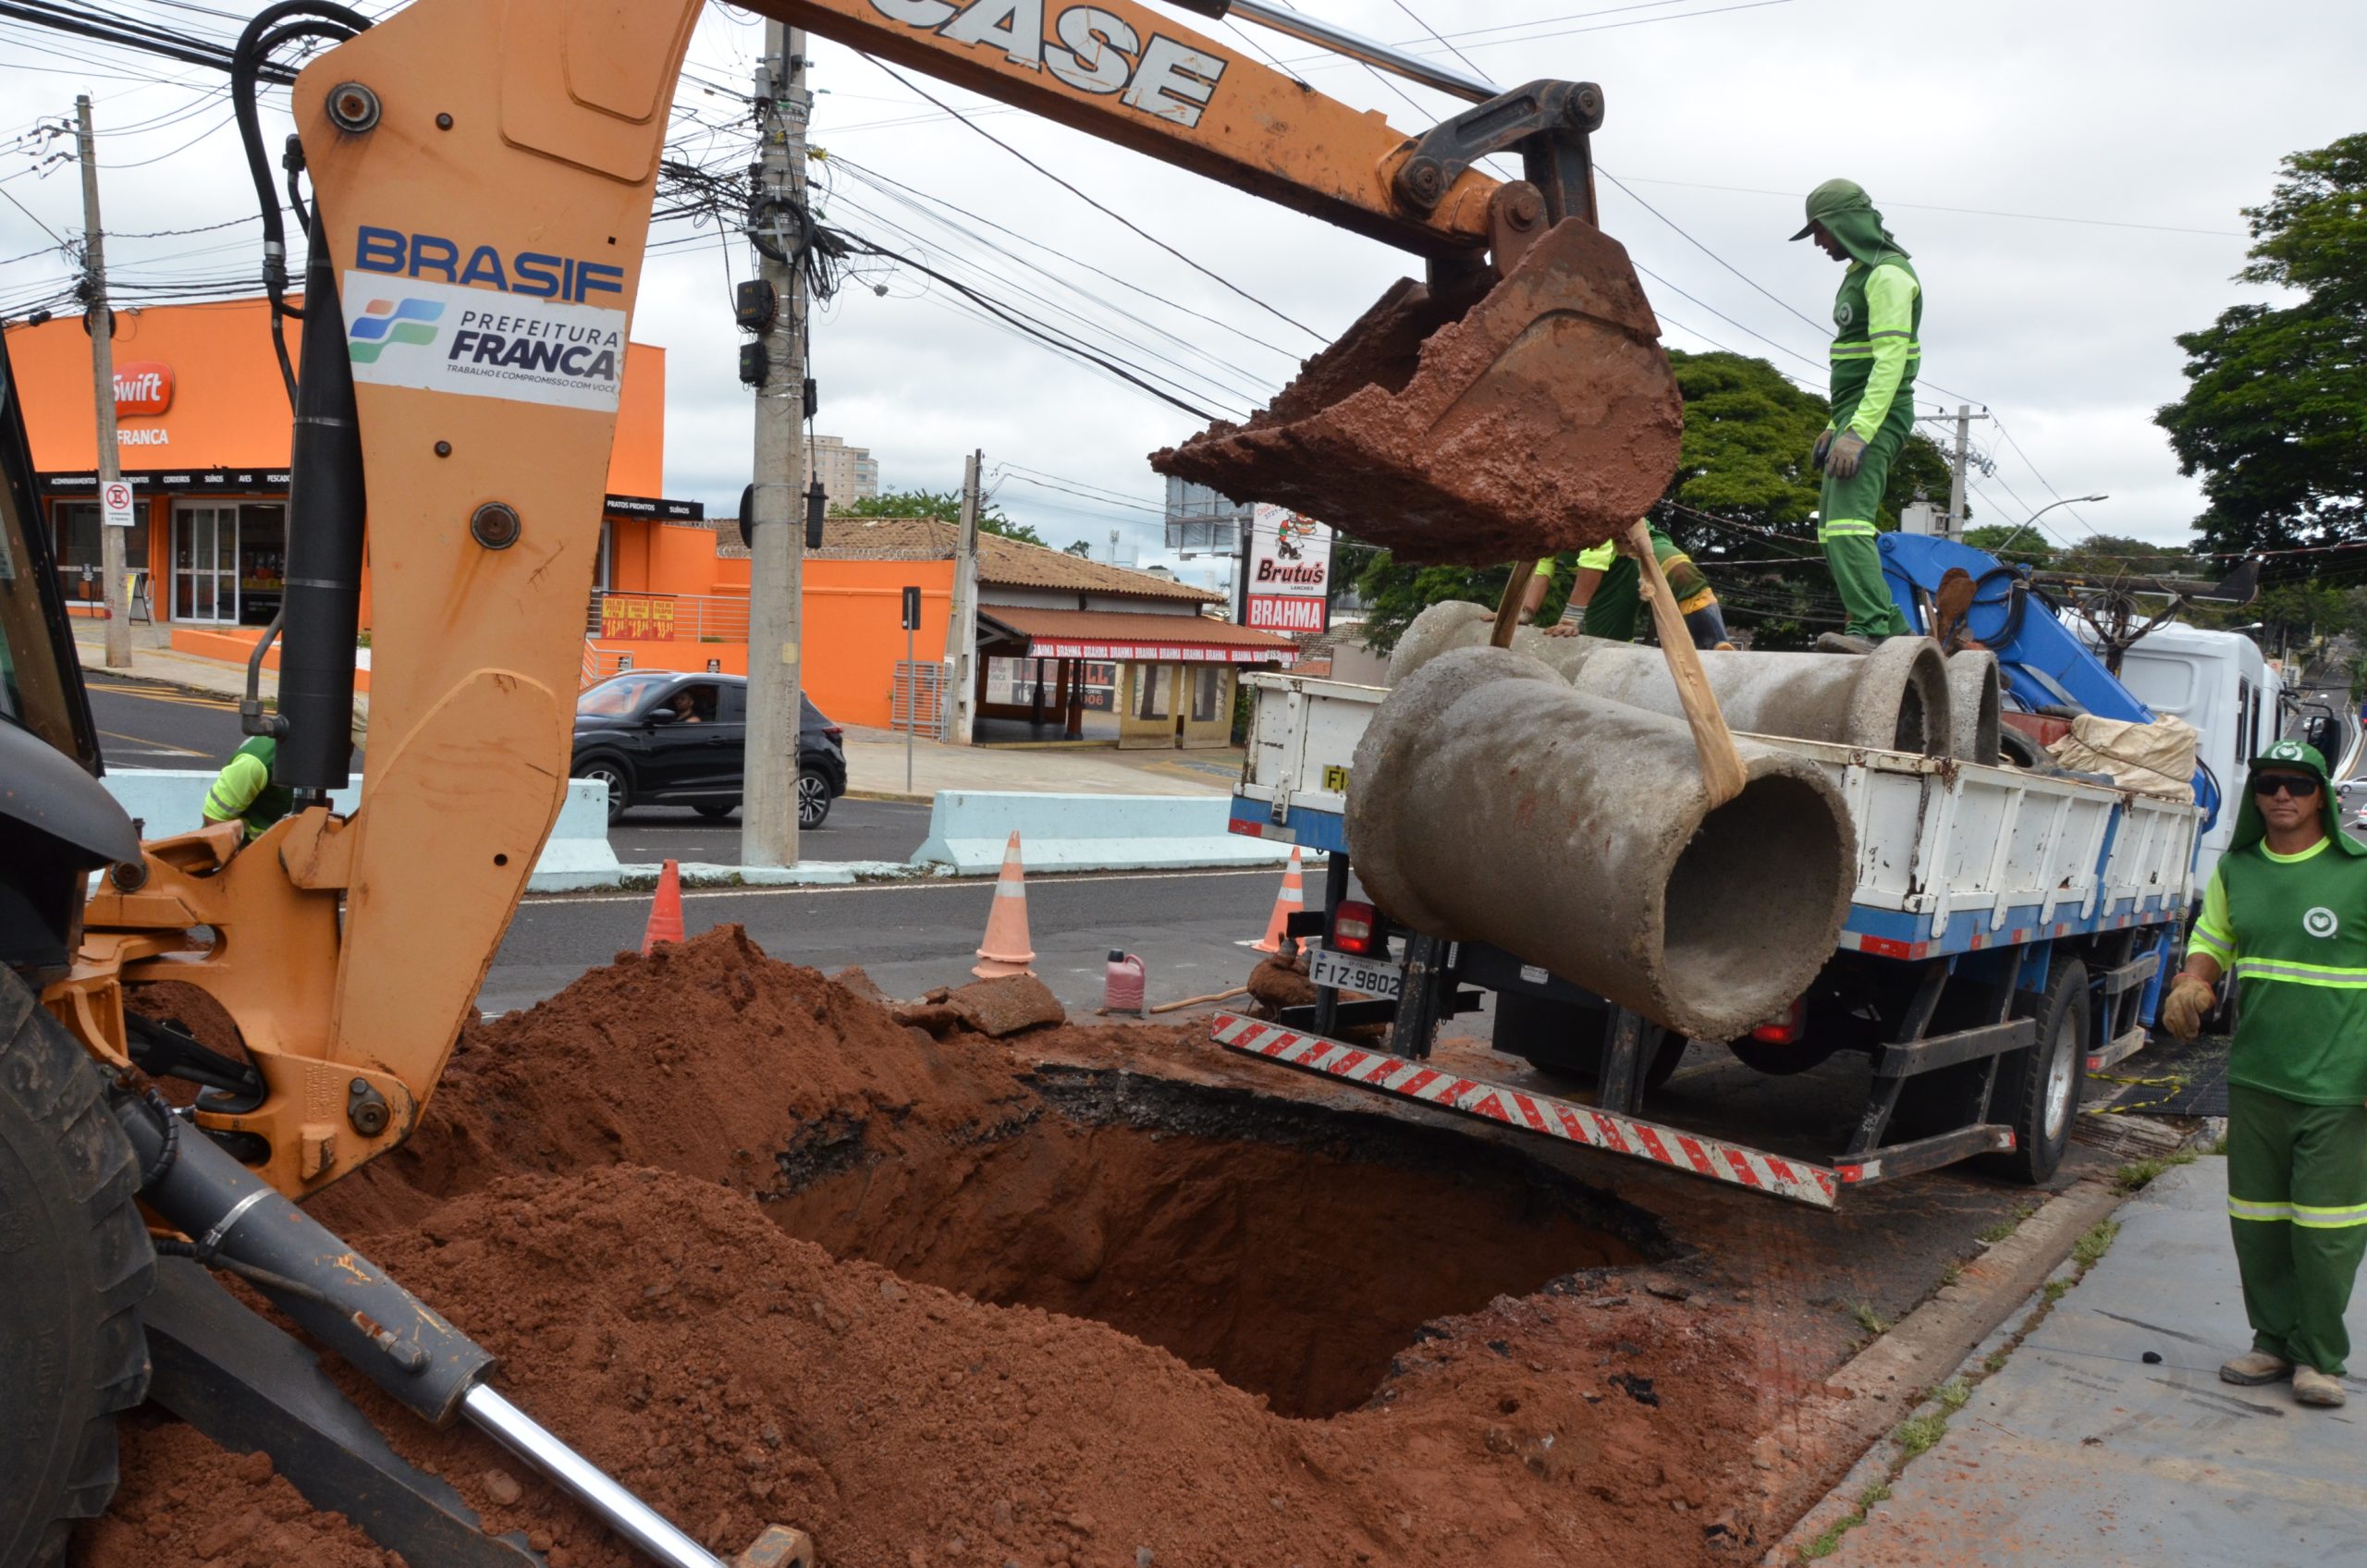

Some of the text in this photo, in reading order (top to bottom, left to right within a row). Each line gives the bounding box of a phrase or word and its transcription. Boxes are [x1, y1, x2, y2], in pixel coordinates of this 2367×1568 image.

[355, 225, 624, 302] BRASIF
[460, 311, 619, 348] PREFEITURA
[448, 330, 615, 381] FRANCA
[113, 373, 162, 401] Swift
[447, 364, 494, 377] TRABALHO
[502, 373, 569, 386] COMPROMISSO
[570, 380, 592, 390] COM
[117, 428, 169, 445] FRANCA
[238, 474, 252, 483] AVES
[629, 502, 656, 511] PRONTOS
[1251, 599, 1320, 629] BRAHMA
[1056, 645, 1081, 657] BRAHMA
[1084, 646, 1108, 657] BRAHMA
[1110, 647, 1133, 658] BRAHMA
[1135, 647, 1158, 658] BRAHMA
[1159, 648, 1181, 659] BRAHMA
[1184, 648, 1204, 659] BRAHMA
[1206, 650, 1226, 660] BRAHMA
